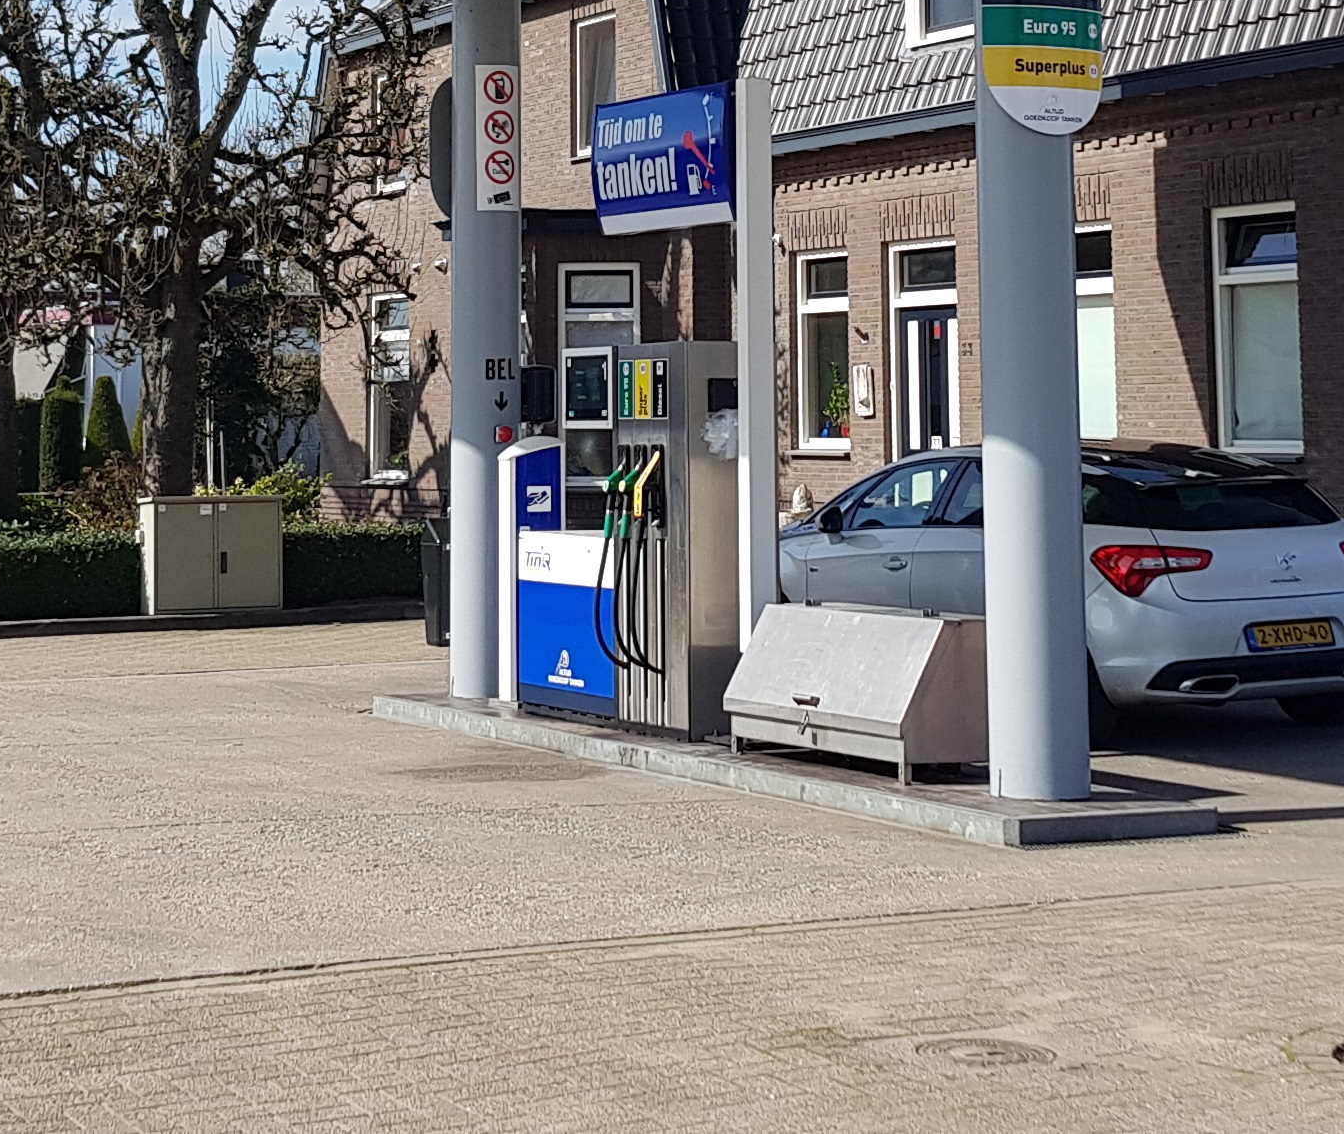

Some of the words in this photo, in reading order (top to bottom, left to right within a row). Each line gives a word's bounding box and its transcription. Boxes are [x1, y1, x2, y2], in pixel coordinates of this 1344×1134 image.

[1023, 19, 1058, 35] Euro
[1061, 21, 1076, 36] 95
[1014, 58, 1086, 77] Superplus
[597, 118, 622, 149] Tijd
[624, 117, 646, 141] om
[648, 112, 663, 139] te
[596, 147, 677, 201] tanken!
[485, 358, 516, 380] BEL
[1257, 624, 1329, 645] 2-XHD-40
